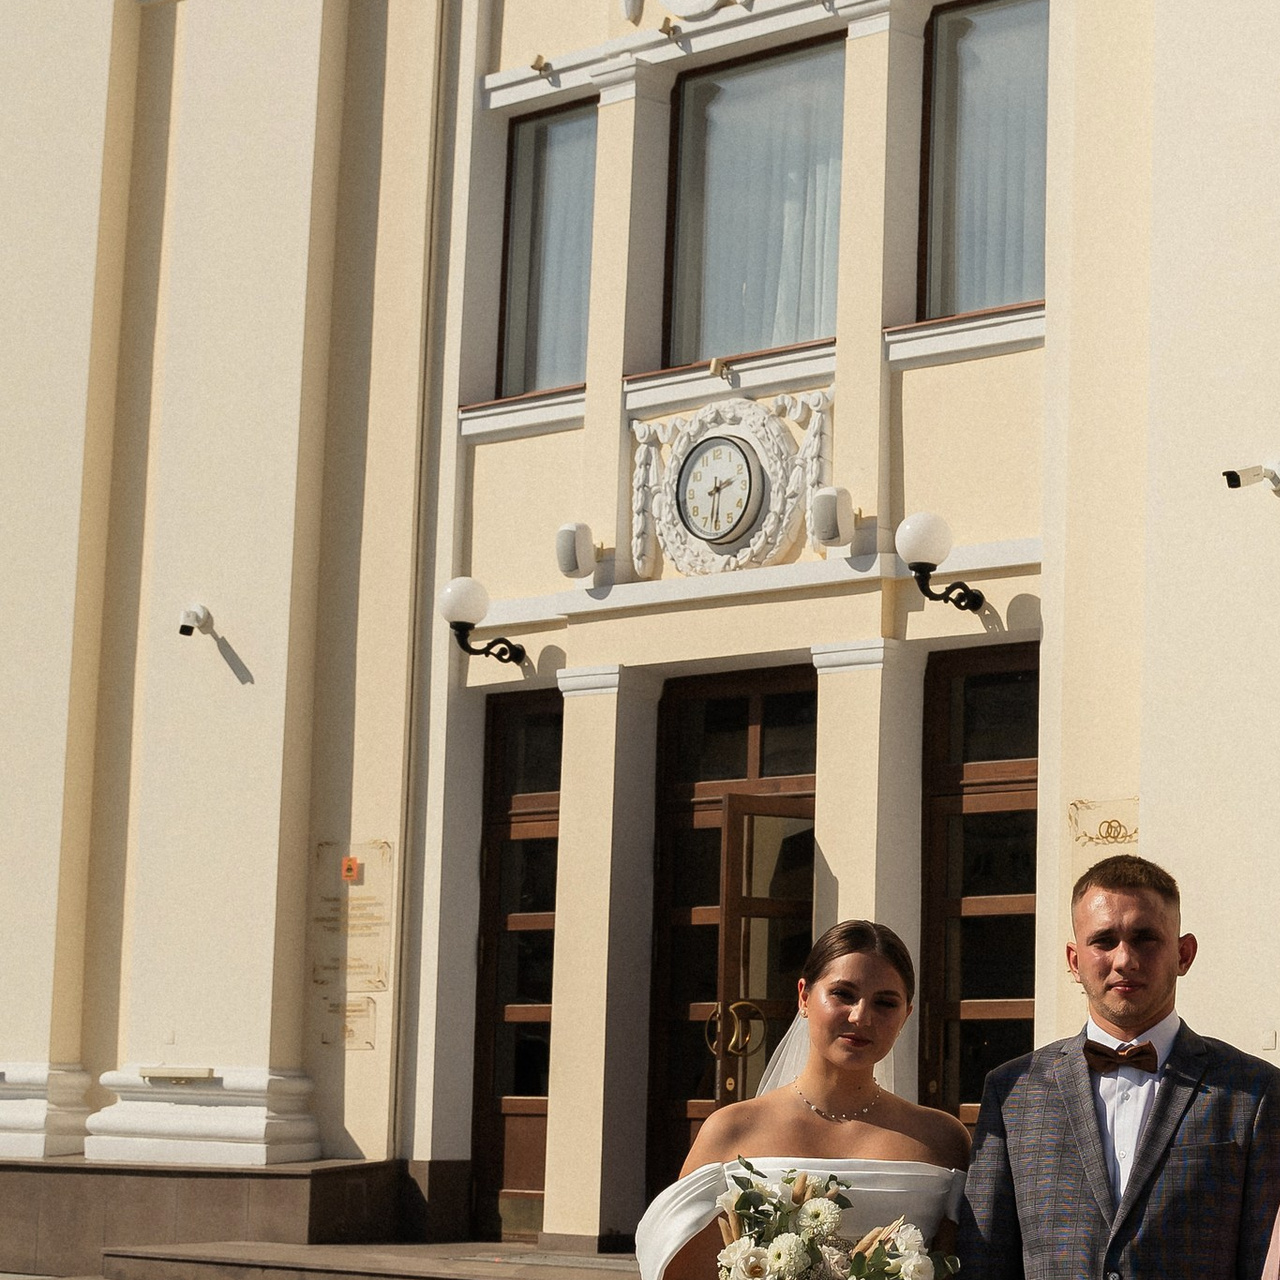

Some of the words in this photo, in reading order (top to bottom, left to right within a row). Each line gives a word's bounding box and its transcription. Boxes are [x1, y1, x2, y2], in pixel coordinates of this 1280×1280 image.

[712, 448, 722, 460] 12
[701, 456, 709, 467] 11
[736, 464, 744, 475] 2
[692, 471, 702, 483] 10
[740, 479, 747, 491] 3
[688, 489, 695, 500] 9
[736, 498, 743, 509] 4
[692, 506, 699, 517] 8
[701, 516, 708, 528] 7
[726, 512, 733, 524] 5
[714, 519, 721, 531] 6
